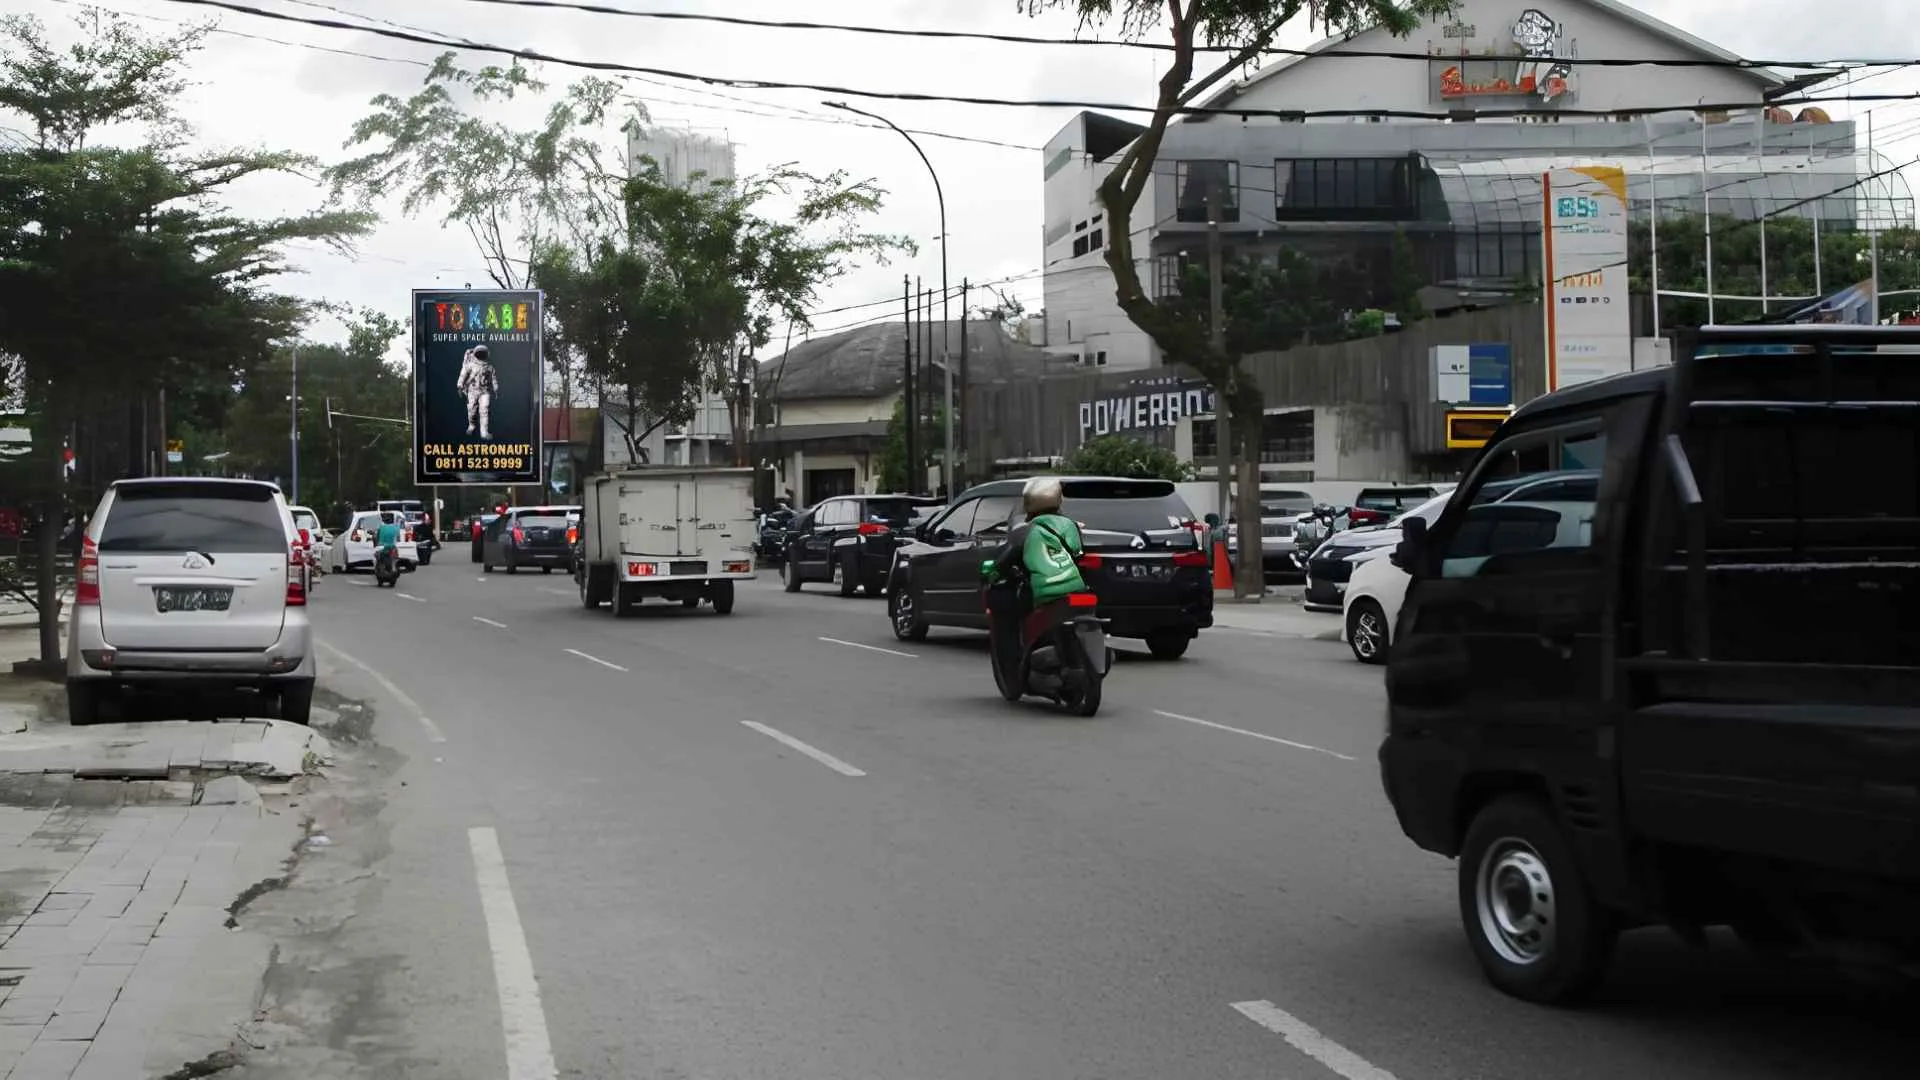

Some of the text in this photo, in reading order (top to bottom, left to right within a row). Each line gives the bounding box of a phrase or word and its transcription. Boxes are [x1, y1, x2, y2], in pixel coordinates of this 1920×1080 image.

[435, 303, 528, 330] TOKABE
[432, 333, 530, 342] SUPER SPACE AVAILABLE
[423, 444, 533, 456] CALL ASTRONAUT:
[435, 457, 523, 469] 0811 523 9999
